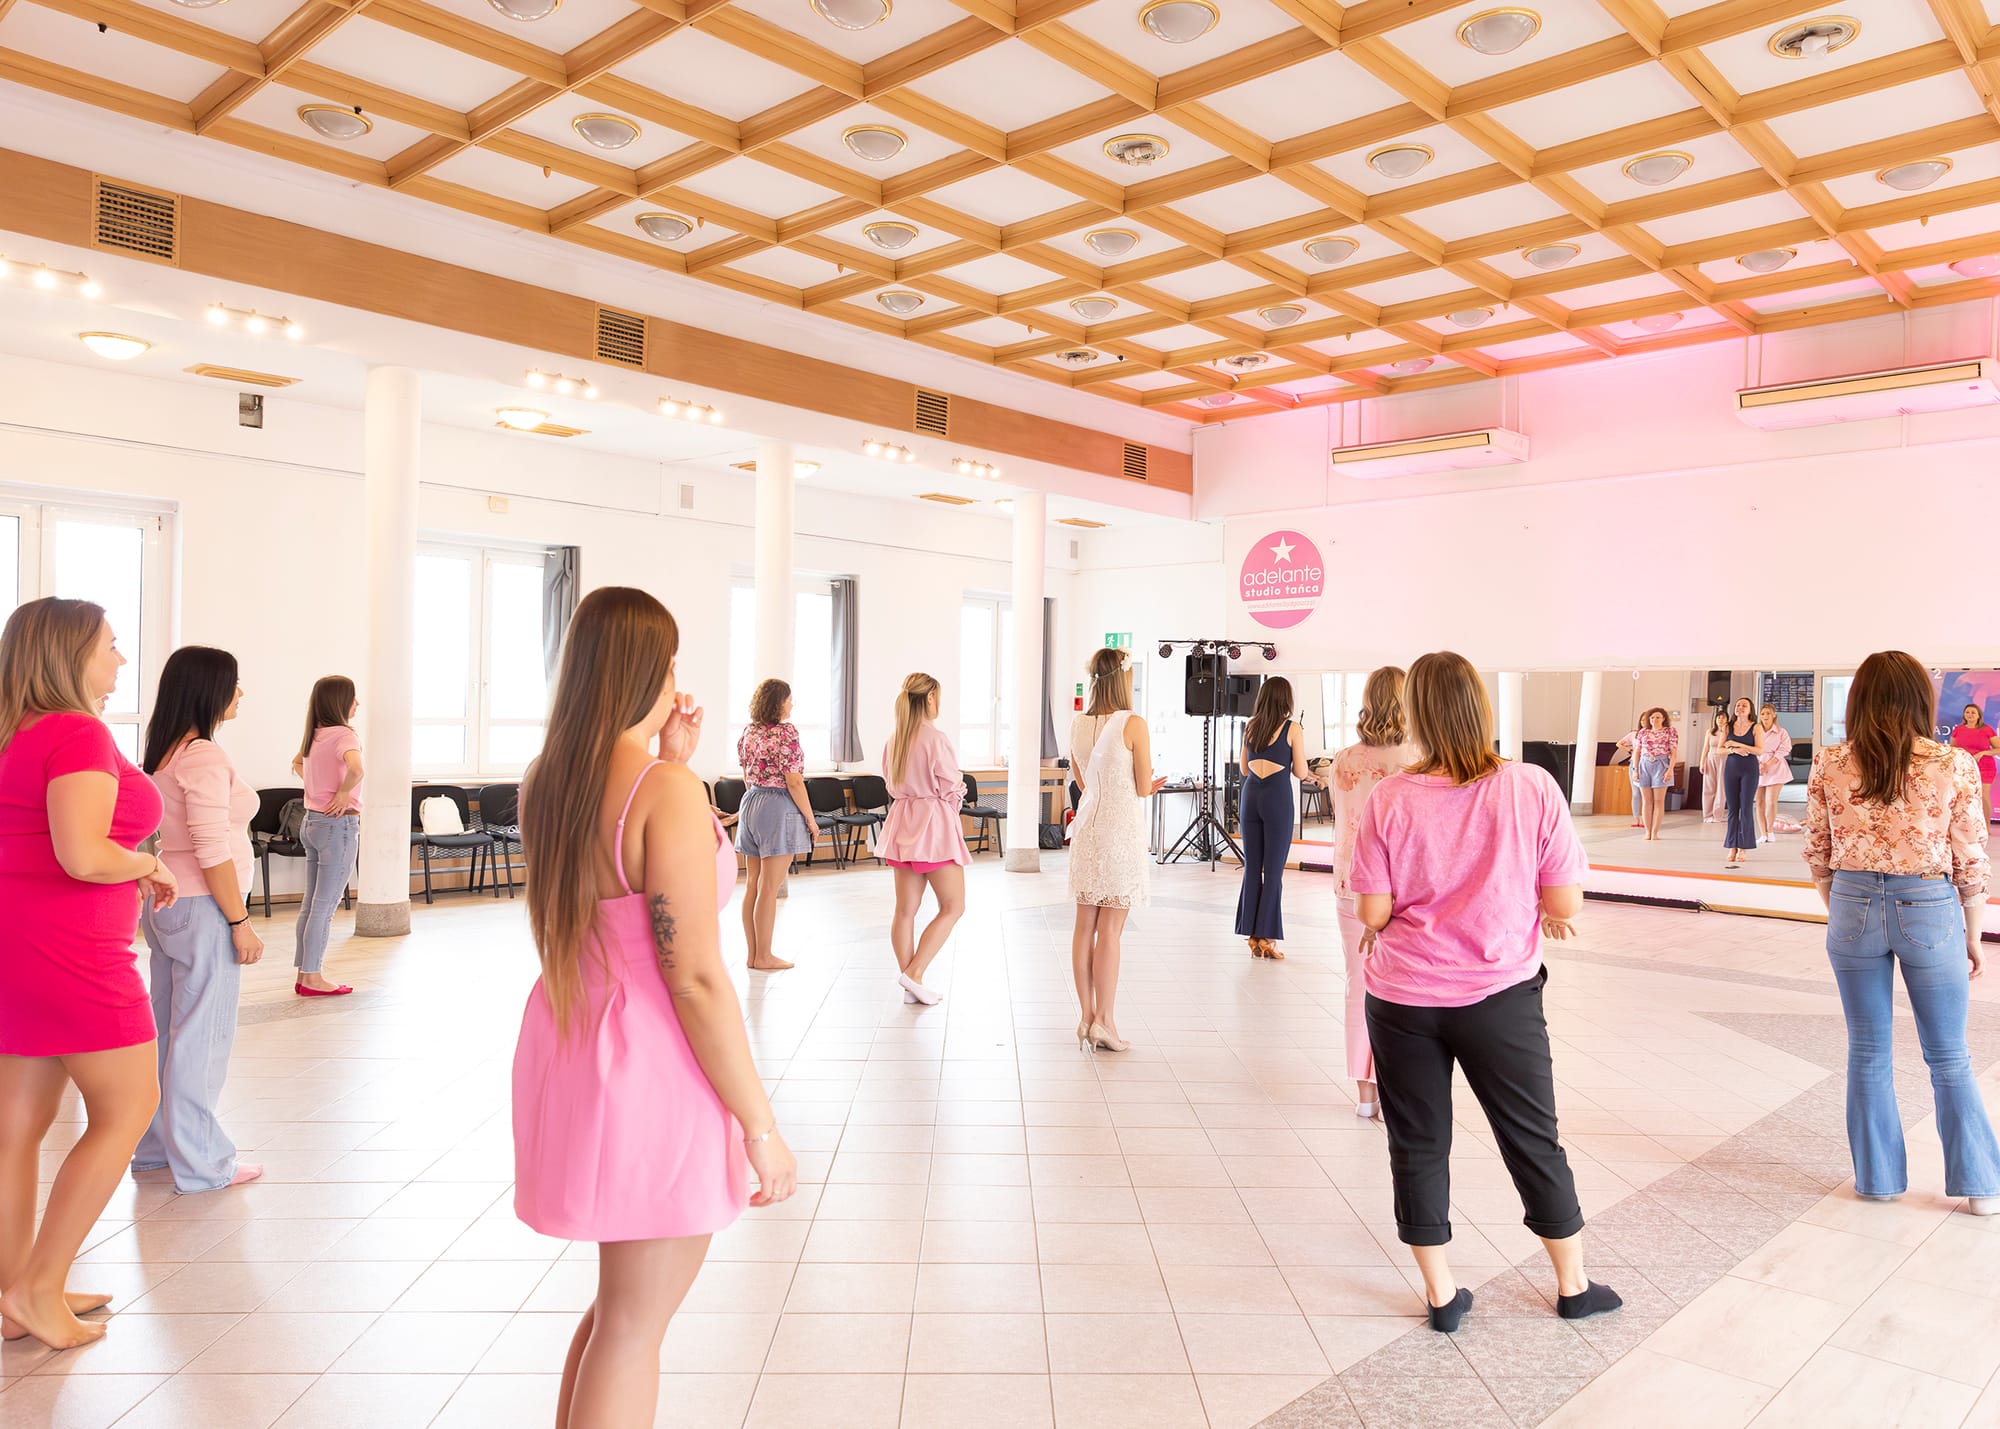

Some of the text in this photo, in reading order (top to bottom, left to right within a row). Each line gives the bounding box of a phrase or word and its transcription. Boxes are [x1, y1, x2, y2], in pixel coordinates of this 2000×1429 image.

[1243, 564, 1321, 586] adelante
[1245, 584, 1319, 597] studio tańca
[1932, 669, 1943, 680] 2
